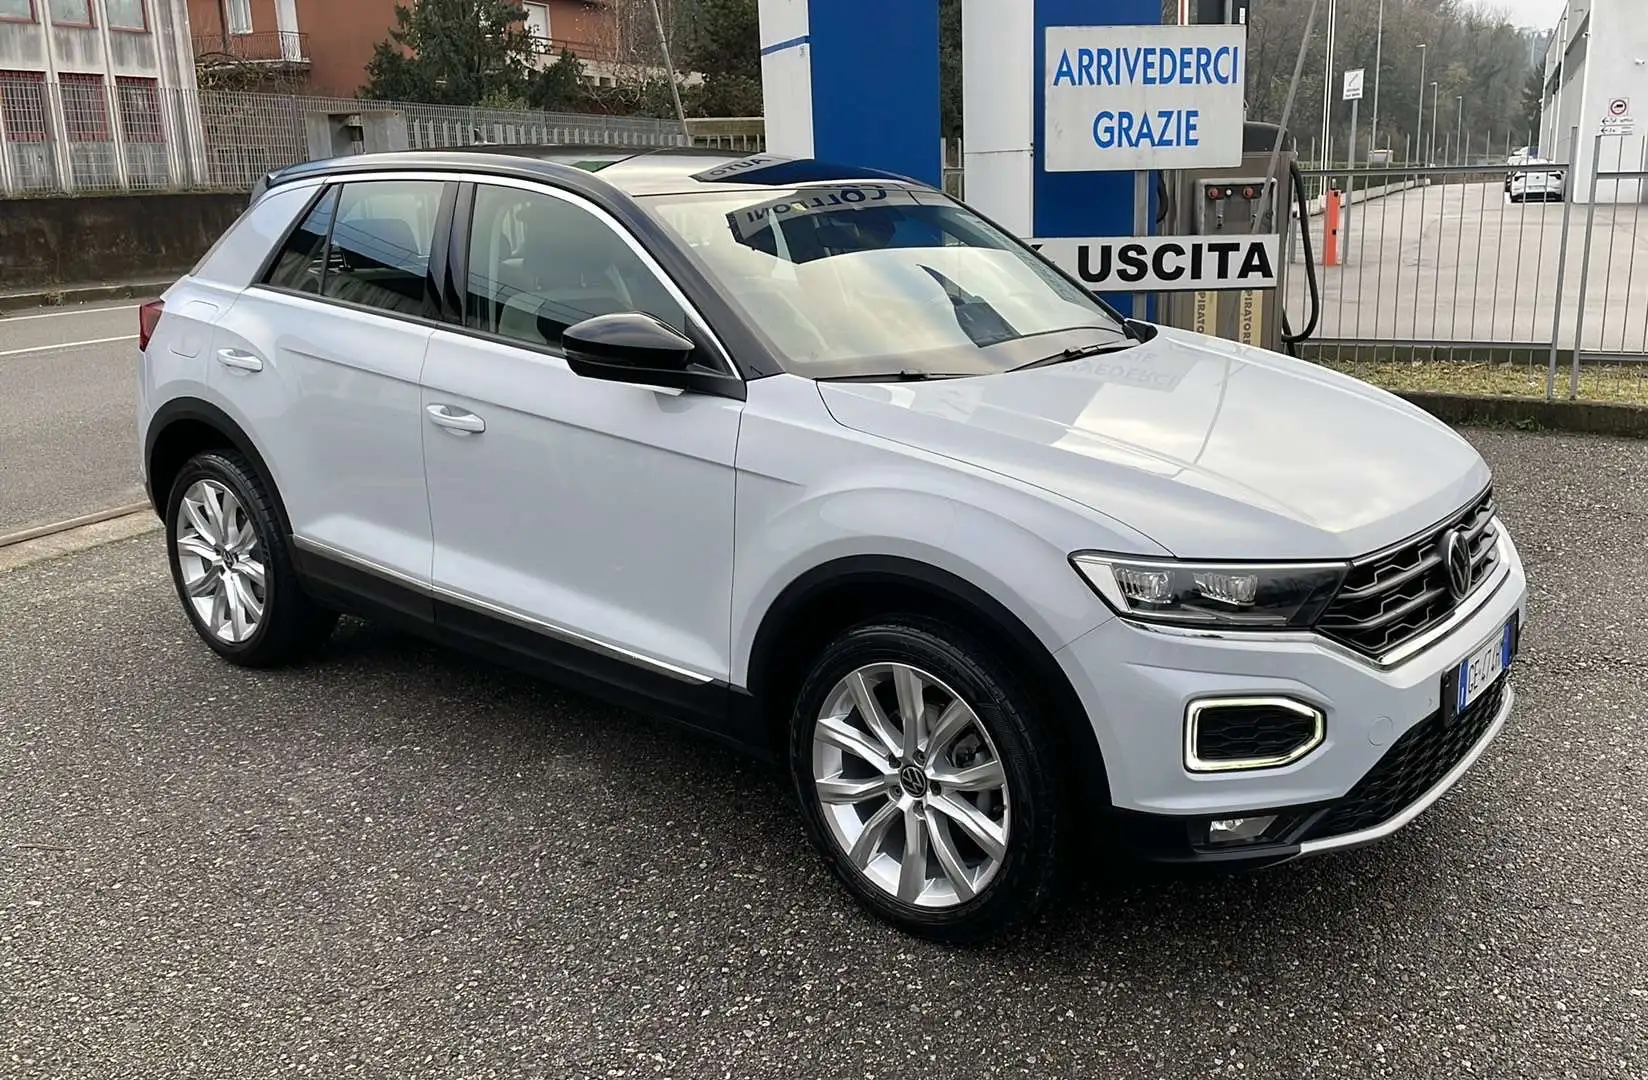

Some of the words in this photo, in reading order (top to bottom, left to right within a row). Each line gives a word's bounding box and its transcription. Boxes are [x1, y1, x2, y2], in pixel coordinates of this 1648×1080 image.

[1053, 46, 1239, 86] ARRIVEDERCI
[1092, 109, 1200, 149] GRAZIE
[1077, 242, 1274, 283] USCITA
